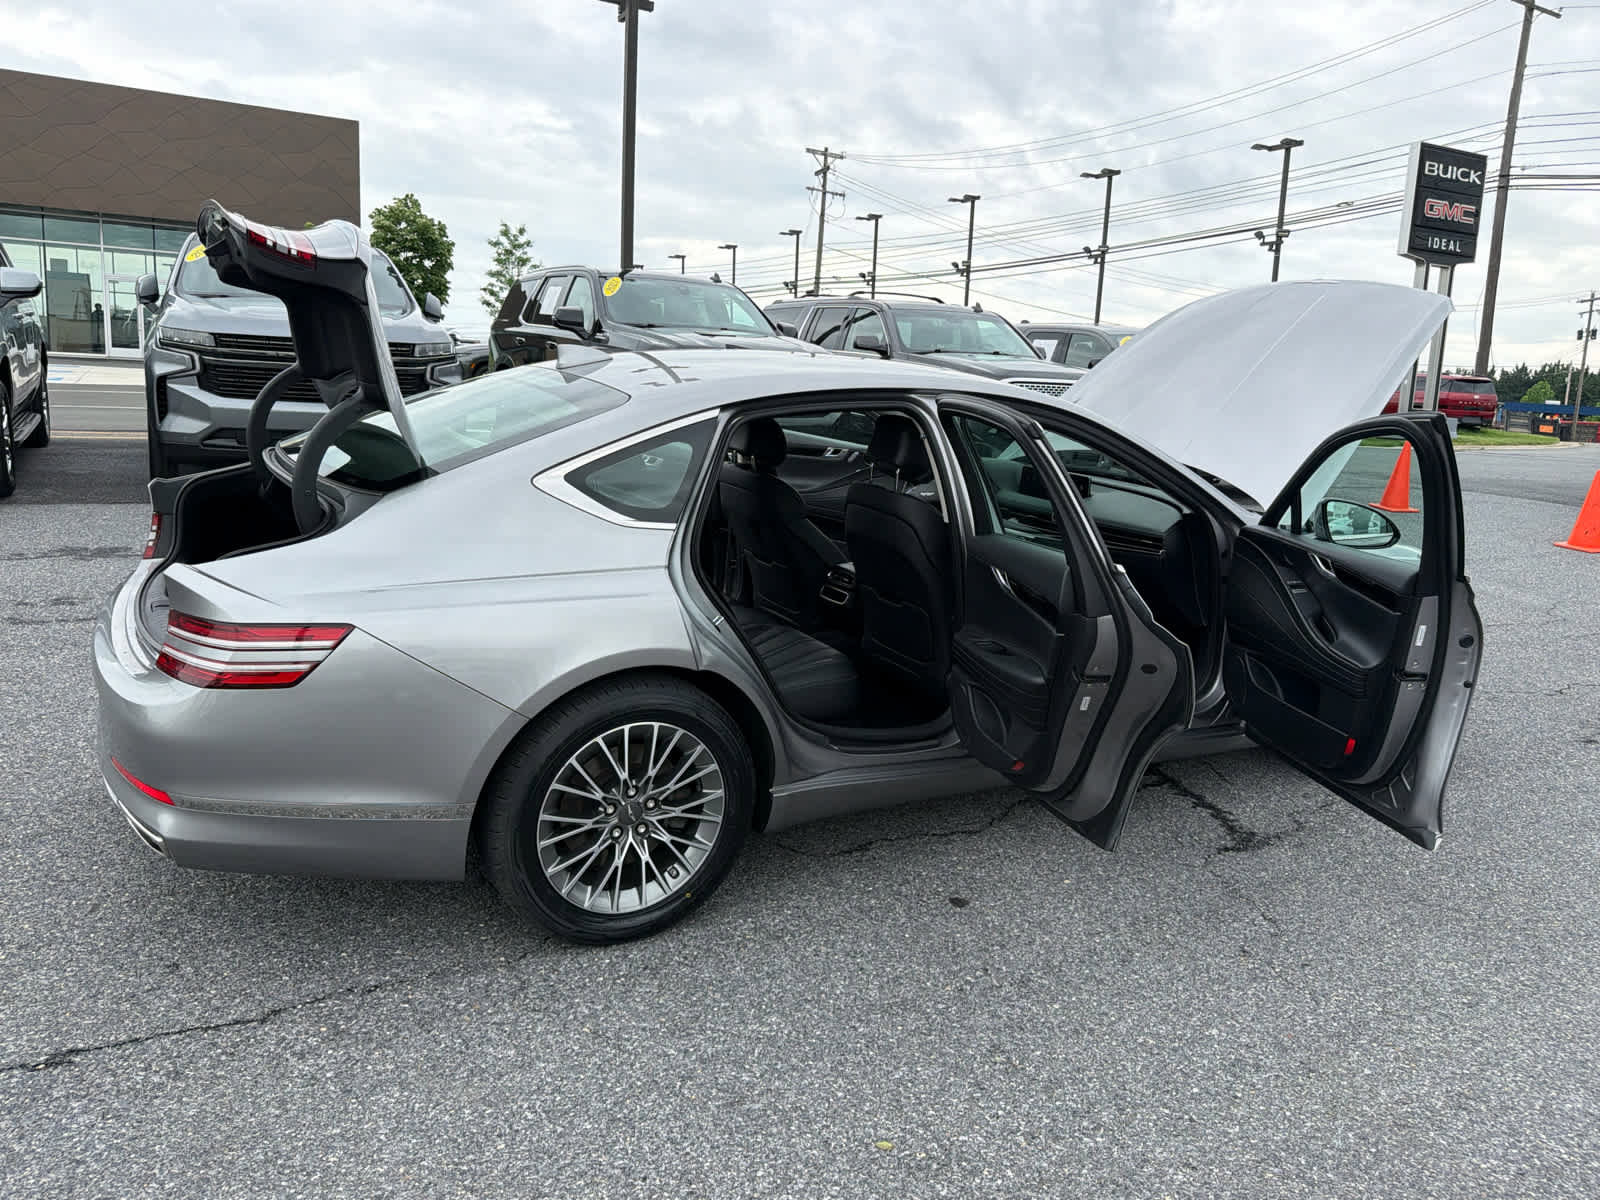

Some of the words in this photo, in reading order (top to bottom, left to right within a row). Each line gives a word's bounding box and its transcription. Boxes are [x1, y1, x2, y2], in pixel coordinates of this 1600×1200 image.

[1424, 161, 1482, 184] BUICK
[1424, 198, 1476, 224] GMC
[1428, 236, 1462, 252] IDEAL
